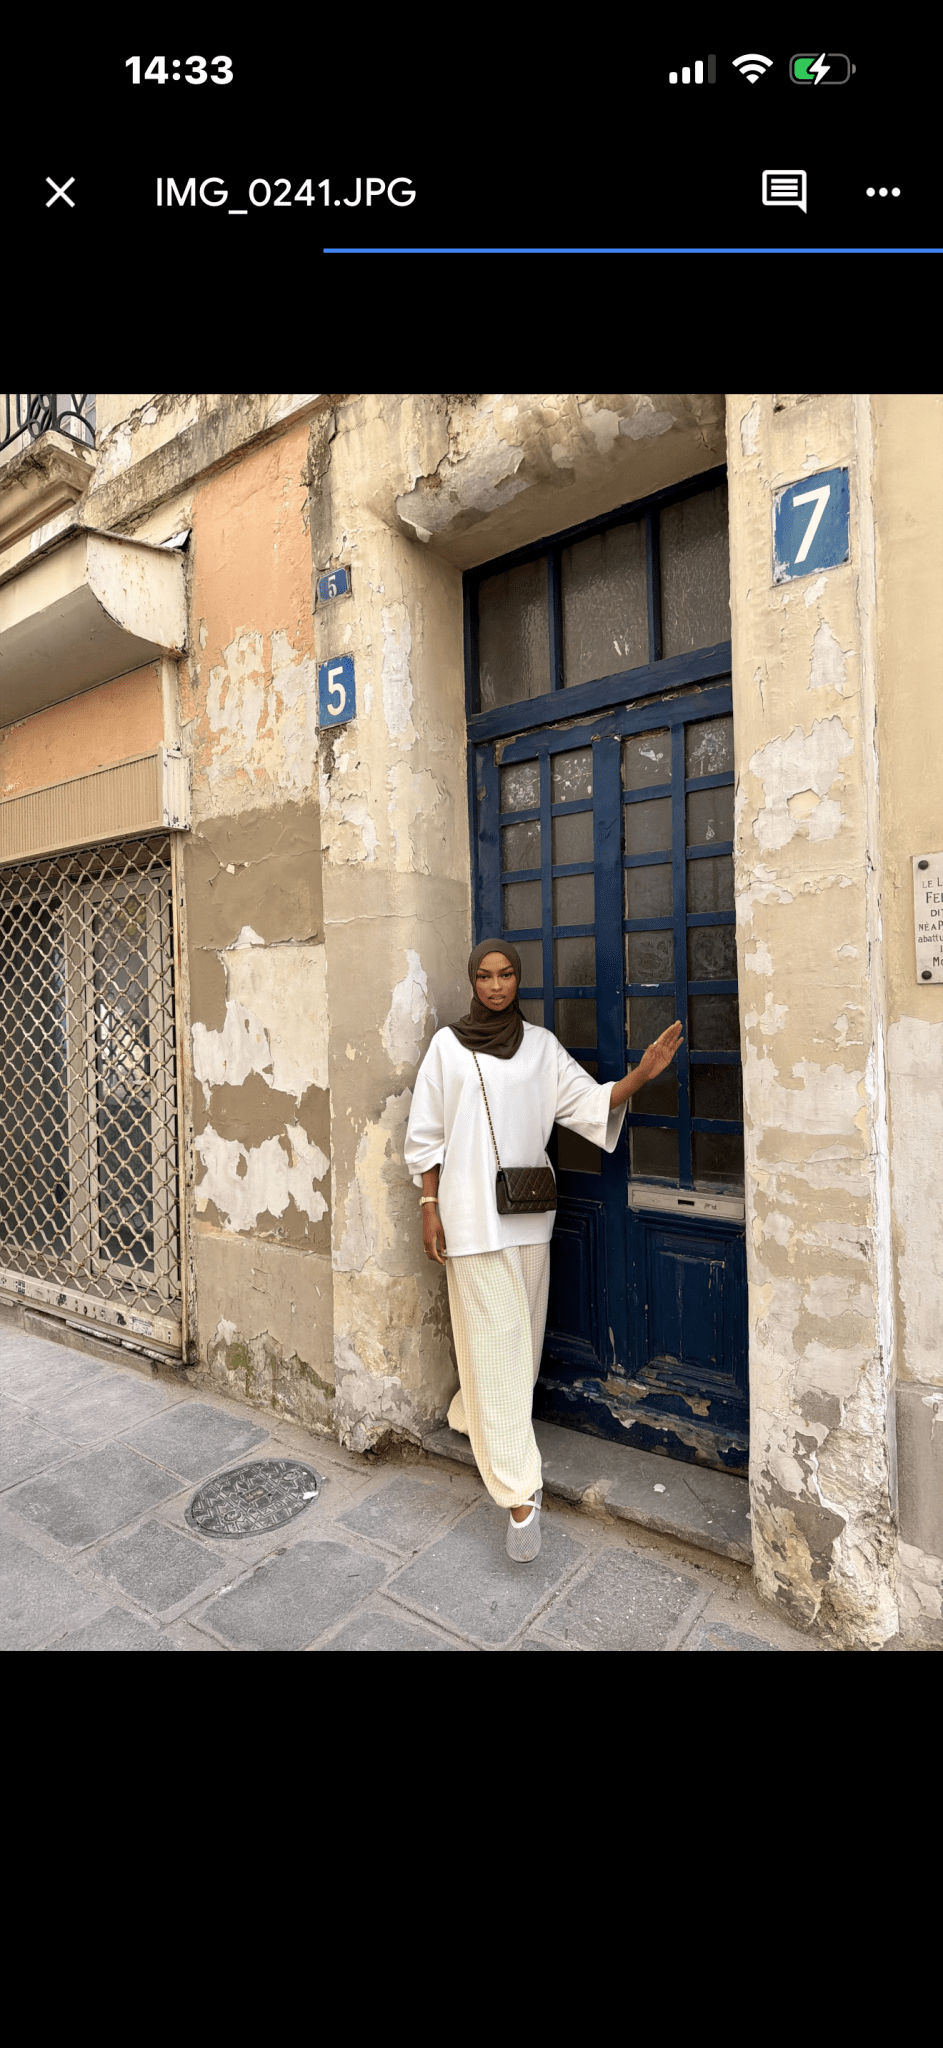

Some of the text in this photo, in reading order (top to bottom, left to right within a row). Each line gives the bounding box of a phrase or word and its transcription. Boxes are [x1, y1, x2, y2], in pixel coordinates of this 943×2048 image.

[793, 484, 831, 565] 7
[327, 574, 338, 598] 5
[326, 665, 347, 717] 5
[922, 880, 933, 889] LE
